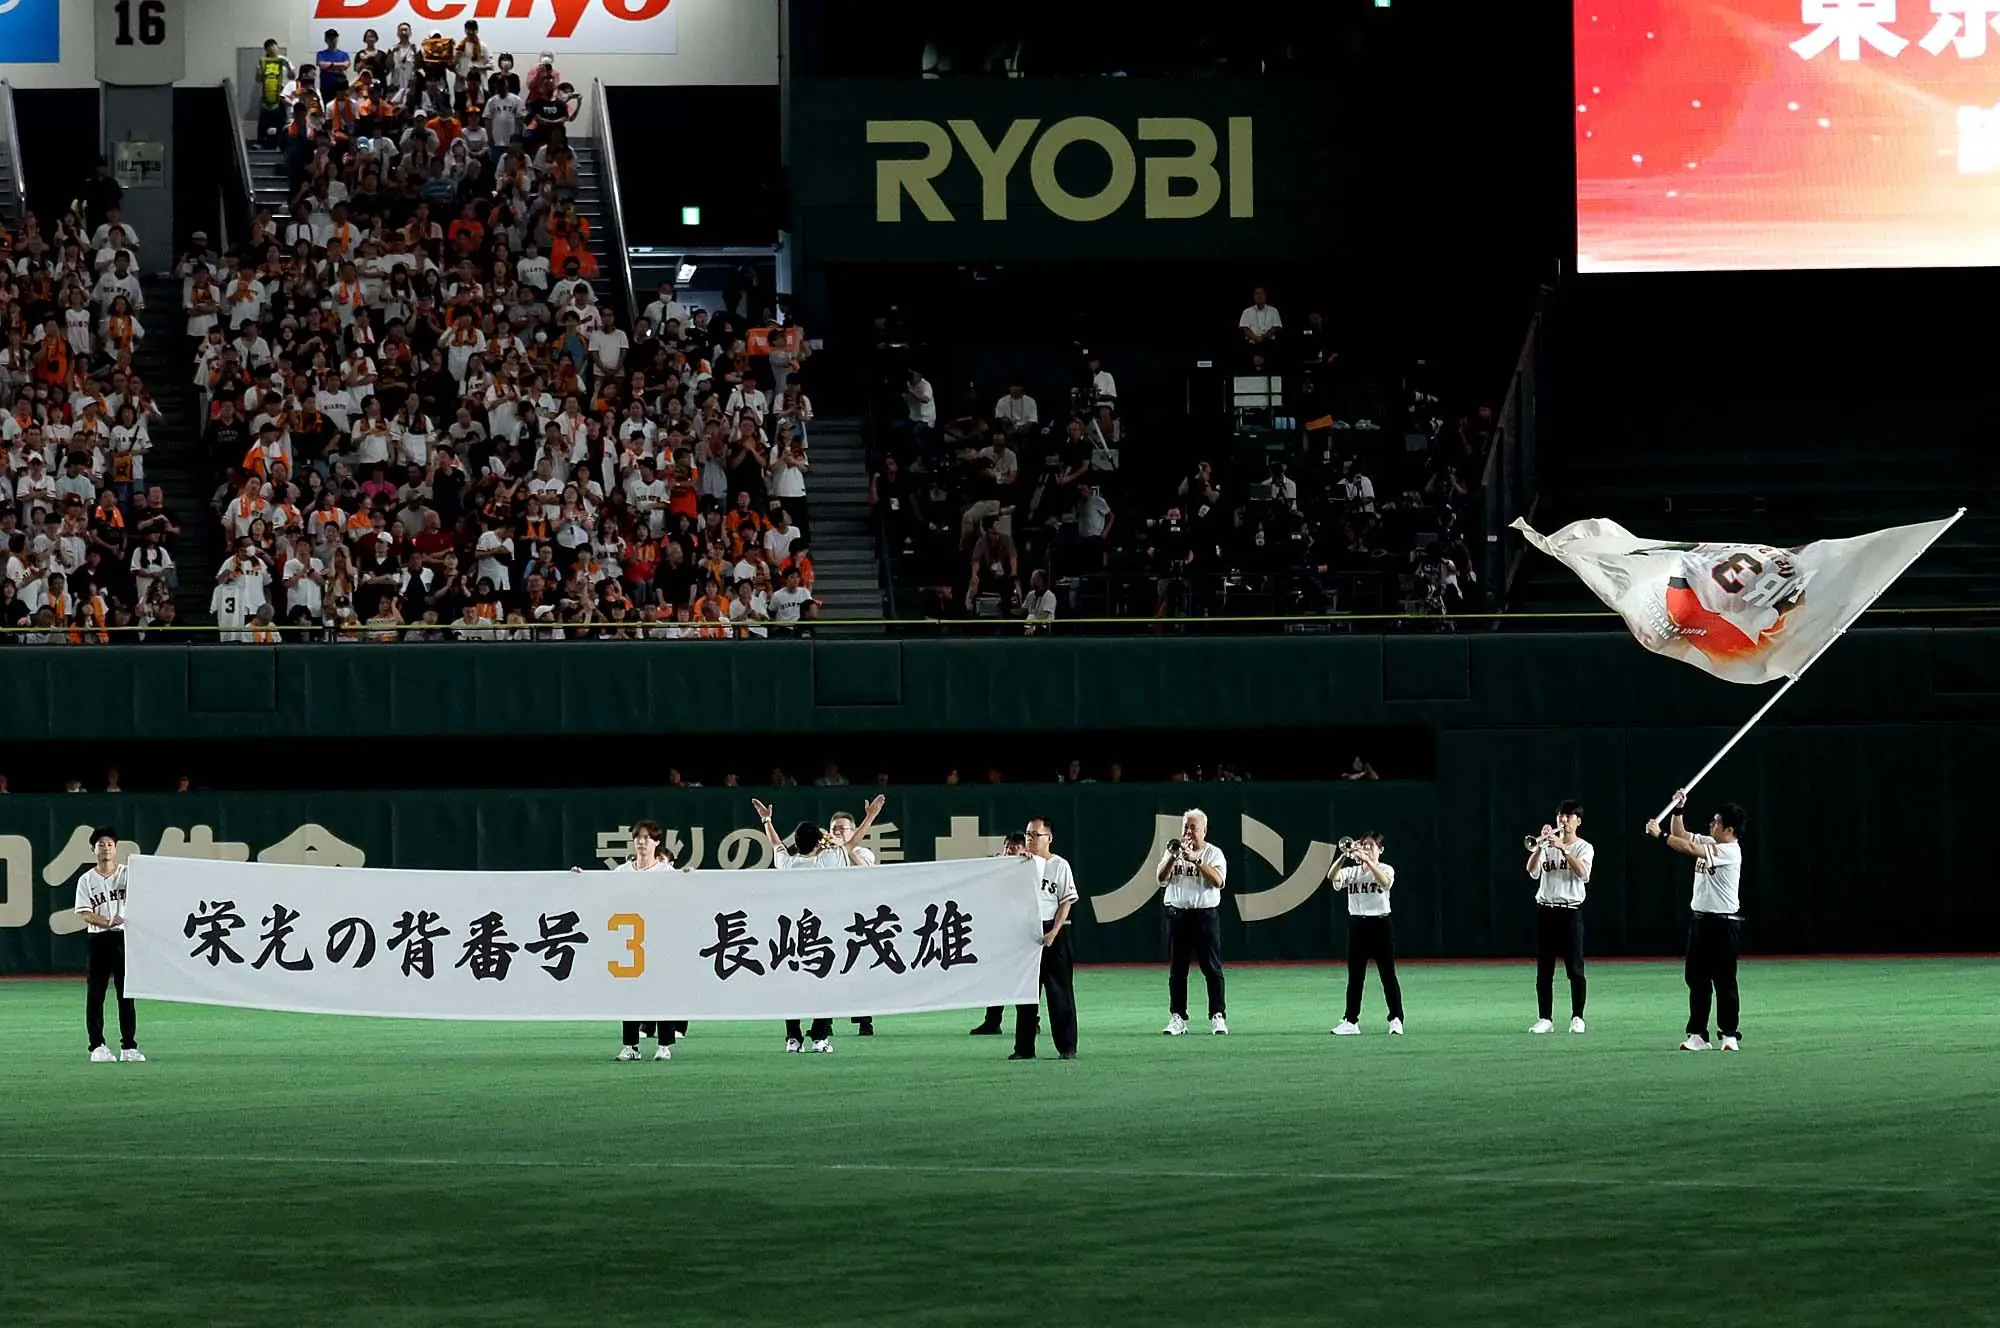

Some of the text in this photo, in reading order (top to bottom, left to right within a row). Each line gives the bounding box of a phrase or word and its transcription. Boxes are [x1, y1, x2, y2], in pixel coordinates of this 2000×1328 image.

[115, 0, 165, 45] 16
[866, 115, 1254, 222] RYOBI
[225, 597, 235, 613] 3
[90, 889, 127, 907] GIANT
[699, 900, 978, 980] 長嶋茂雄
